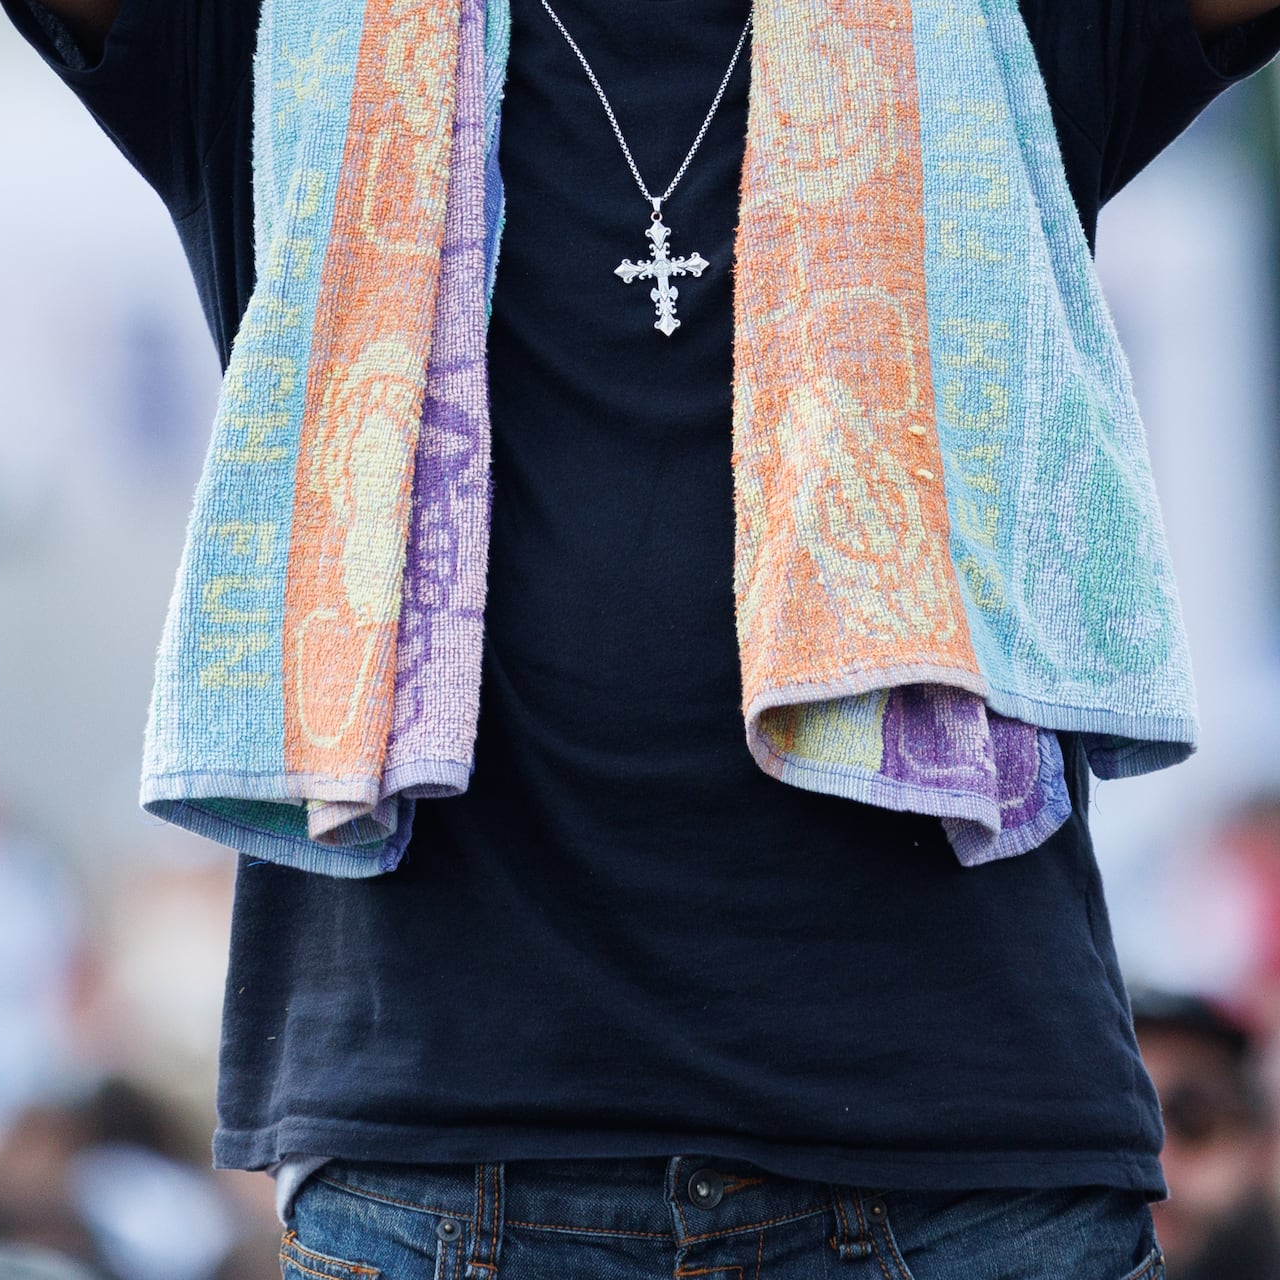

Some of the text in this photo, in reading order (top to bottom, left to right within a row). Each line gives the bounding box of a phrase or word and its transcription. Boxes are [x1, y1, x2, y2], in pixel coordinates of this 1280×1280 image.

[935, 98, 1012, 614] BEACH FUN
[198, 519, 275, 690] FUN
